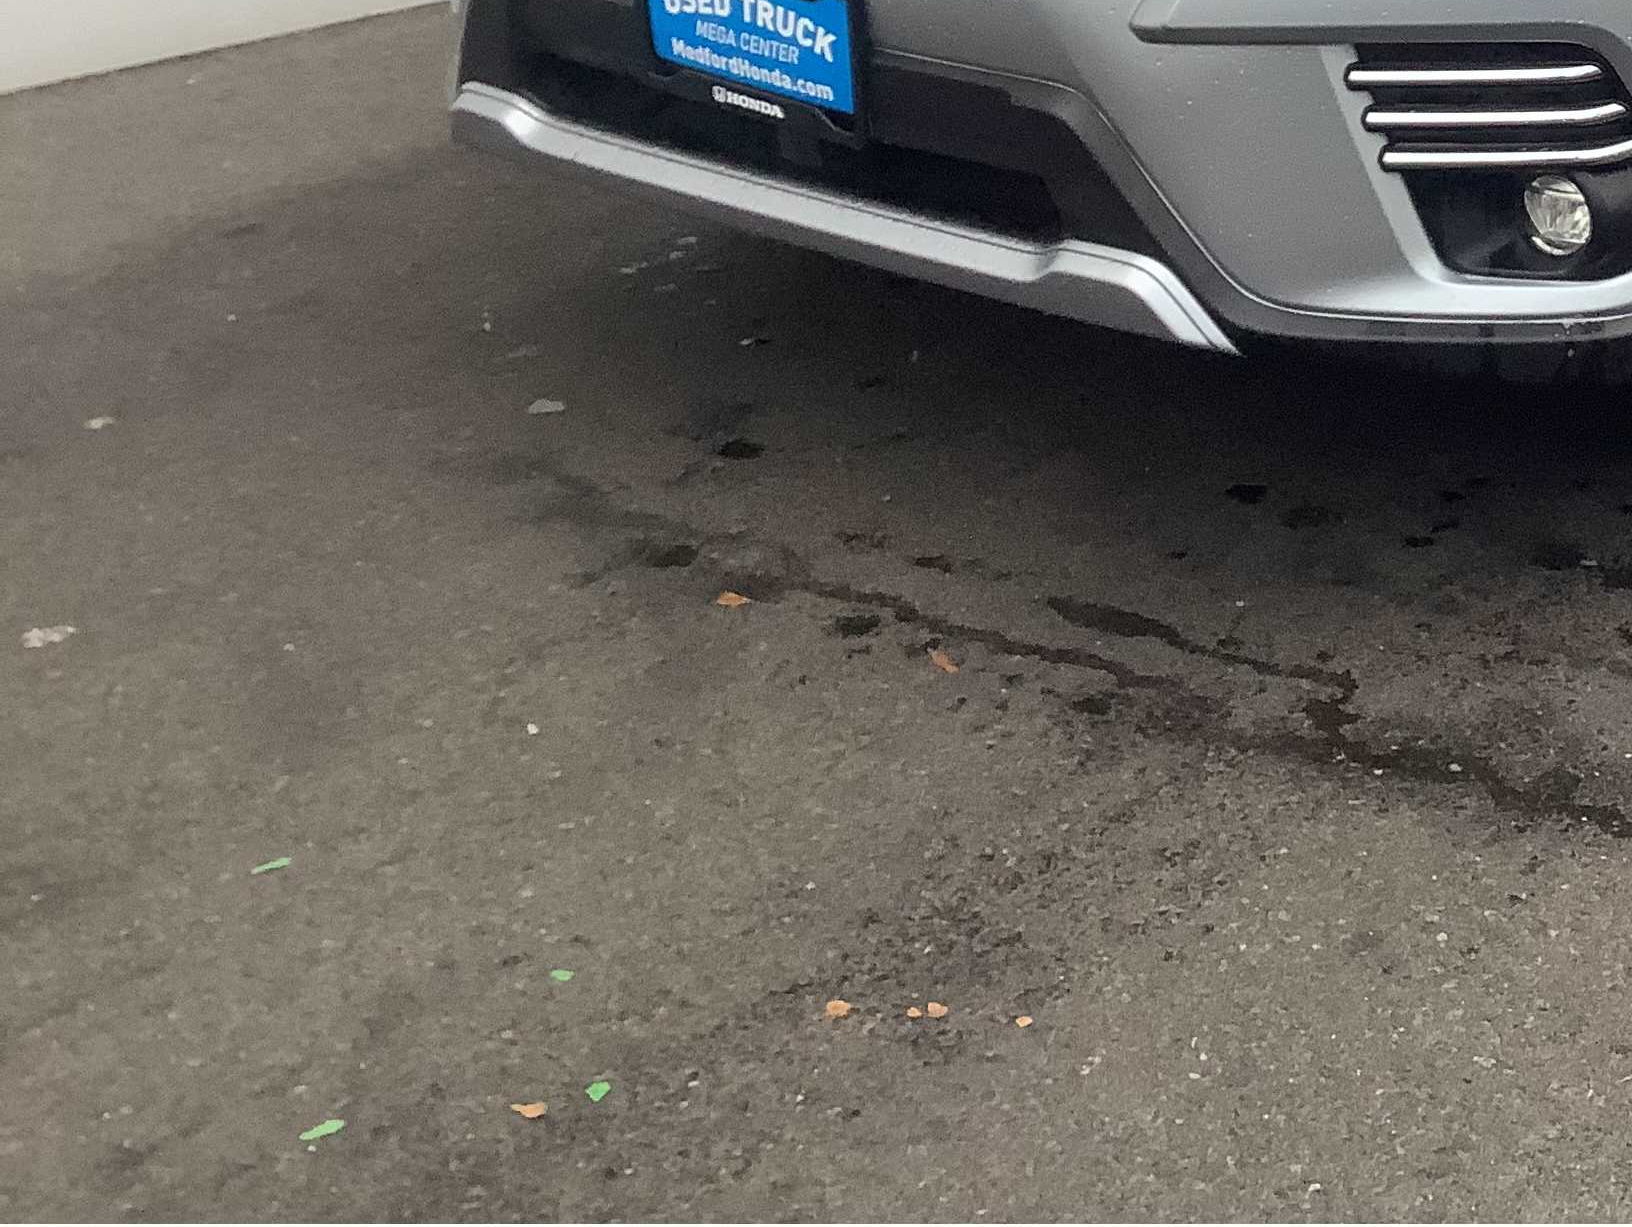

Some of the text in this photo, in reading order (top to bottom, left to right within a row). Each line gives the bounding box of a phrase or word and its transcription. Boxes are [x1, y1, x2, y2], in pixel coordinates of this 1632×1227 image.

[696, 20, 800, 65] MEGA CENTER
[671, 37, 834, 101] MedfordHonda.com
[726, 87, 785, 119] HONDA
